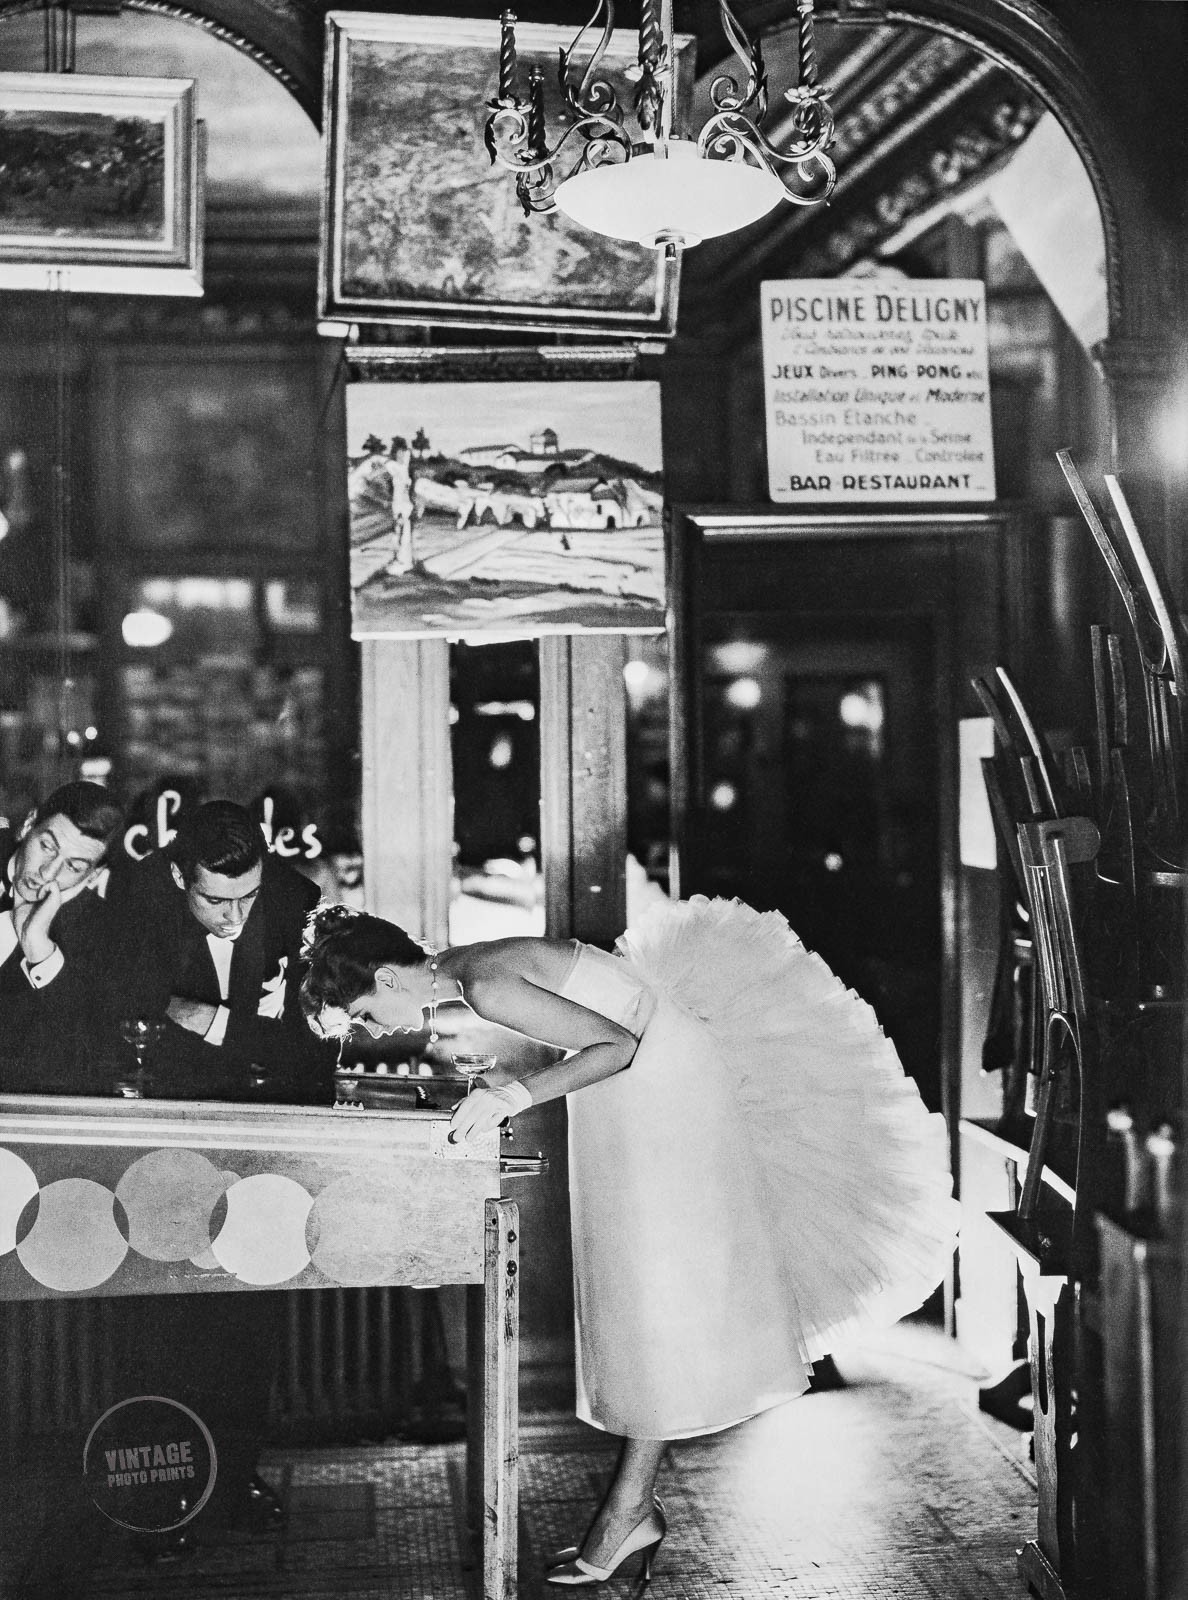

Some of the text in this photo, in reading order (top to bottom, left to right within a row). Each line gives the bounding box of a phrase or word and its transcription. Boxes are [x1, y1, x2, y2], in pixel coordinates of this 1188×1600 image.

[771, 294, 980, 322] PISCINE DELIGNY
[771, 364, 814, 380] JEUX
[871, 364, 908, 380] PING
[917, 364, 962, 380] PONG
[775, 409, 836, 427] Bassin
[815, 448, 845, 464] Eau
[789, 473, 971, 491] BAR RESTAURANT
